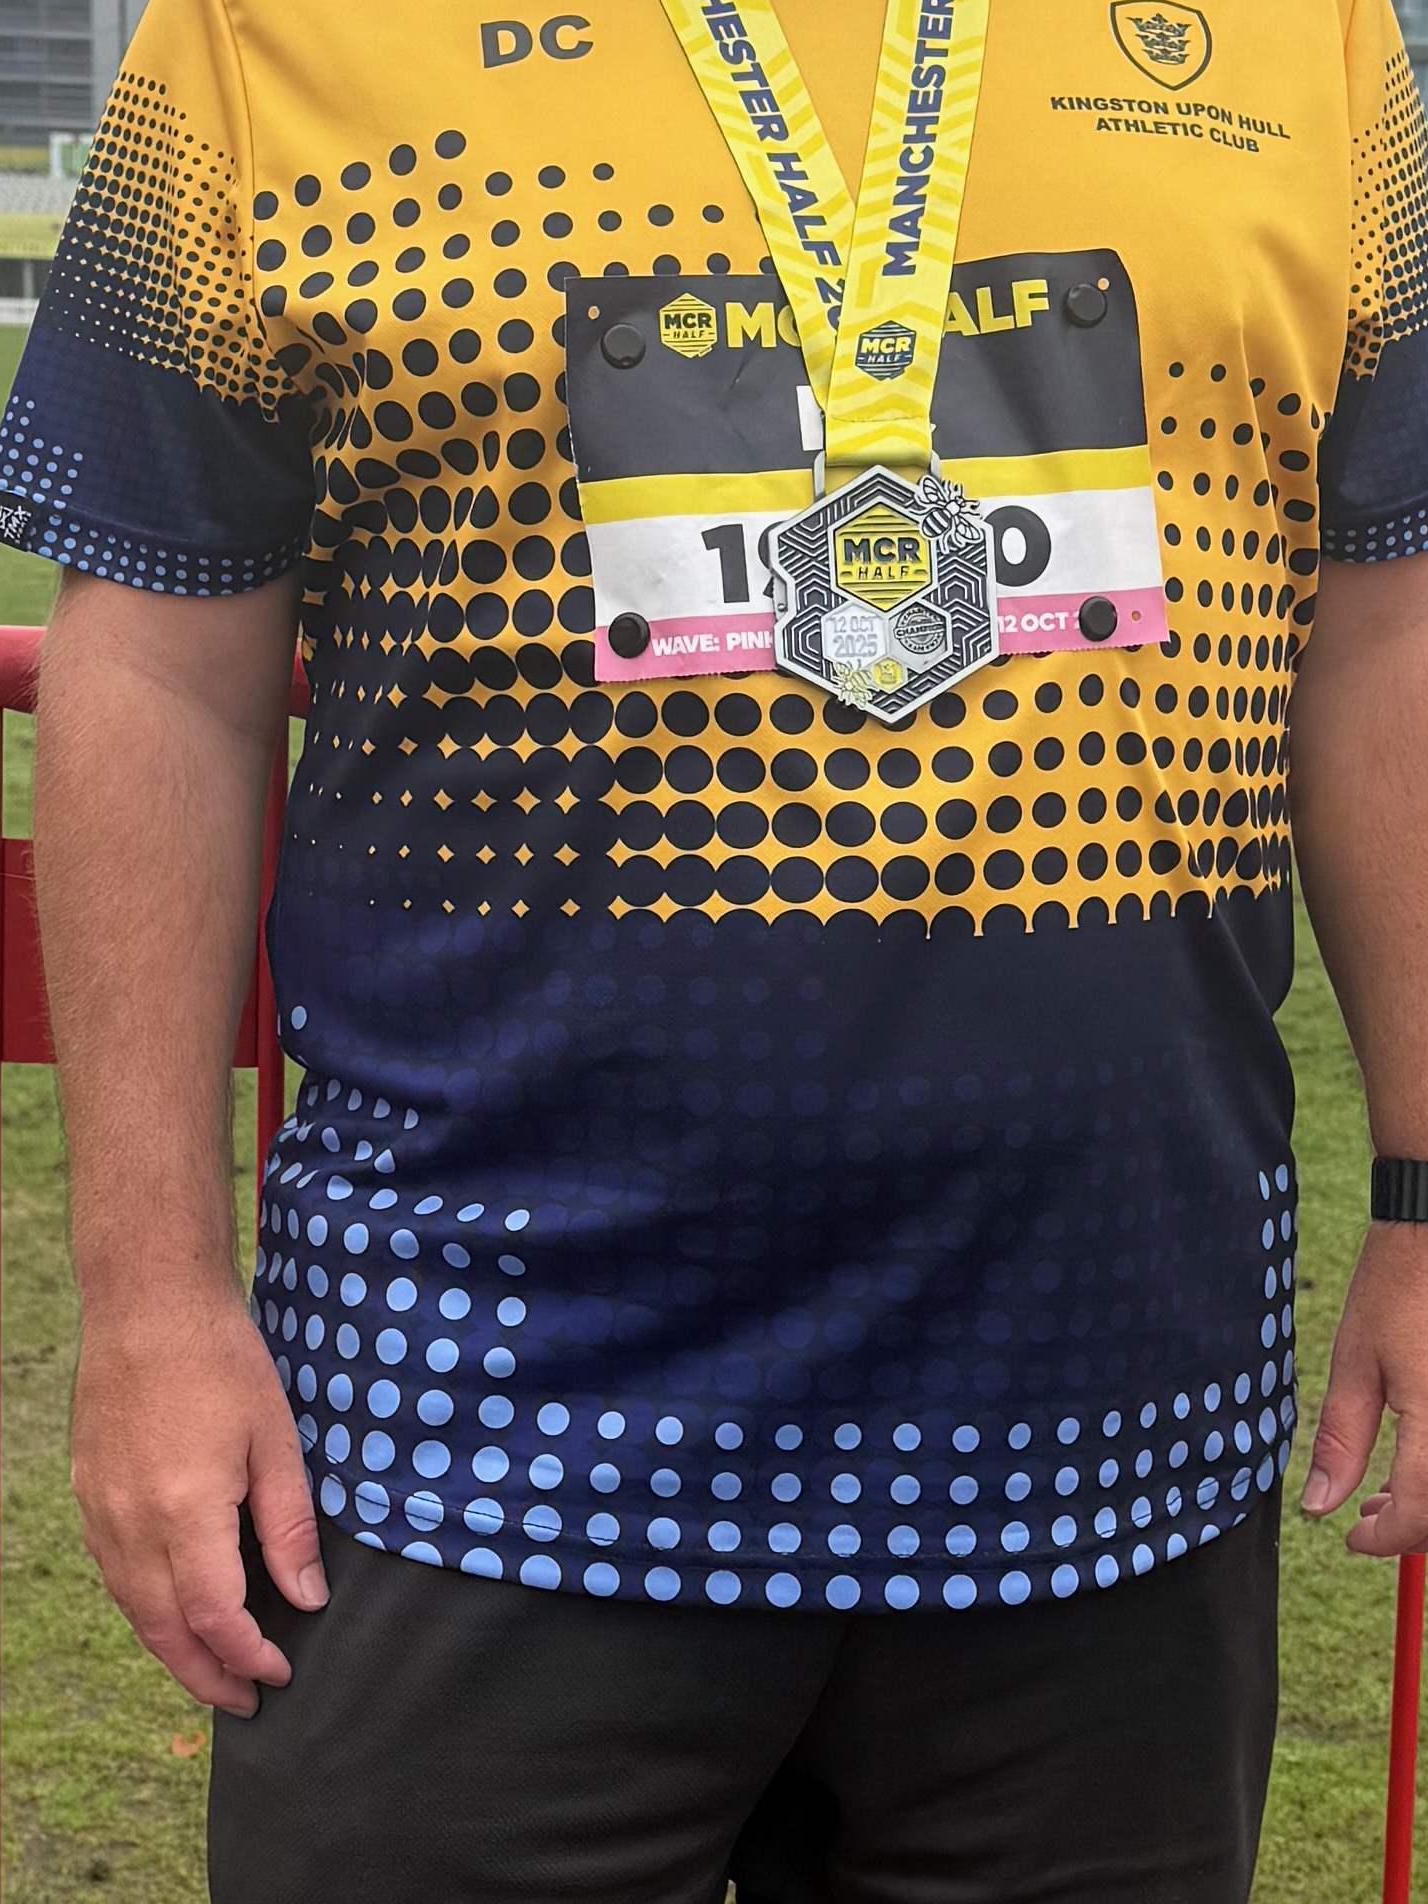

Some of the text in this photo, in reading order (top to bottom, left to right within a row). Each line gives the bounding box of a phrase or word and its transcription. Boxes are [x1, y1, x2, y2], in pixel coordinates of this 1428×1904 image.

[480, 15, 593, 68] DC
[1050, 96, 1291, 139] KINGSTON UPON HULL
[1096, 117, 1260, 152] ATHLETIC CLUB
[767, 152, 843, 266] HALF
[942, 279, 1050, 338] ALF
[664, 313, 712, 329] MCR
[673, 330, 705, 339] HALF
[860, 338, 912, 355] MCR
[867, 354, 901, 364] HALF
[843, 537, 921, 565] MCR
[858, 566, 909, 580] HALF
[833, 616, 875, 633] 12 OCT
[1020, 612, 1069, 633] OCT
[651, 633, 720, 656] WAVE:
[834, 634, 878, 657] 2025
